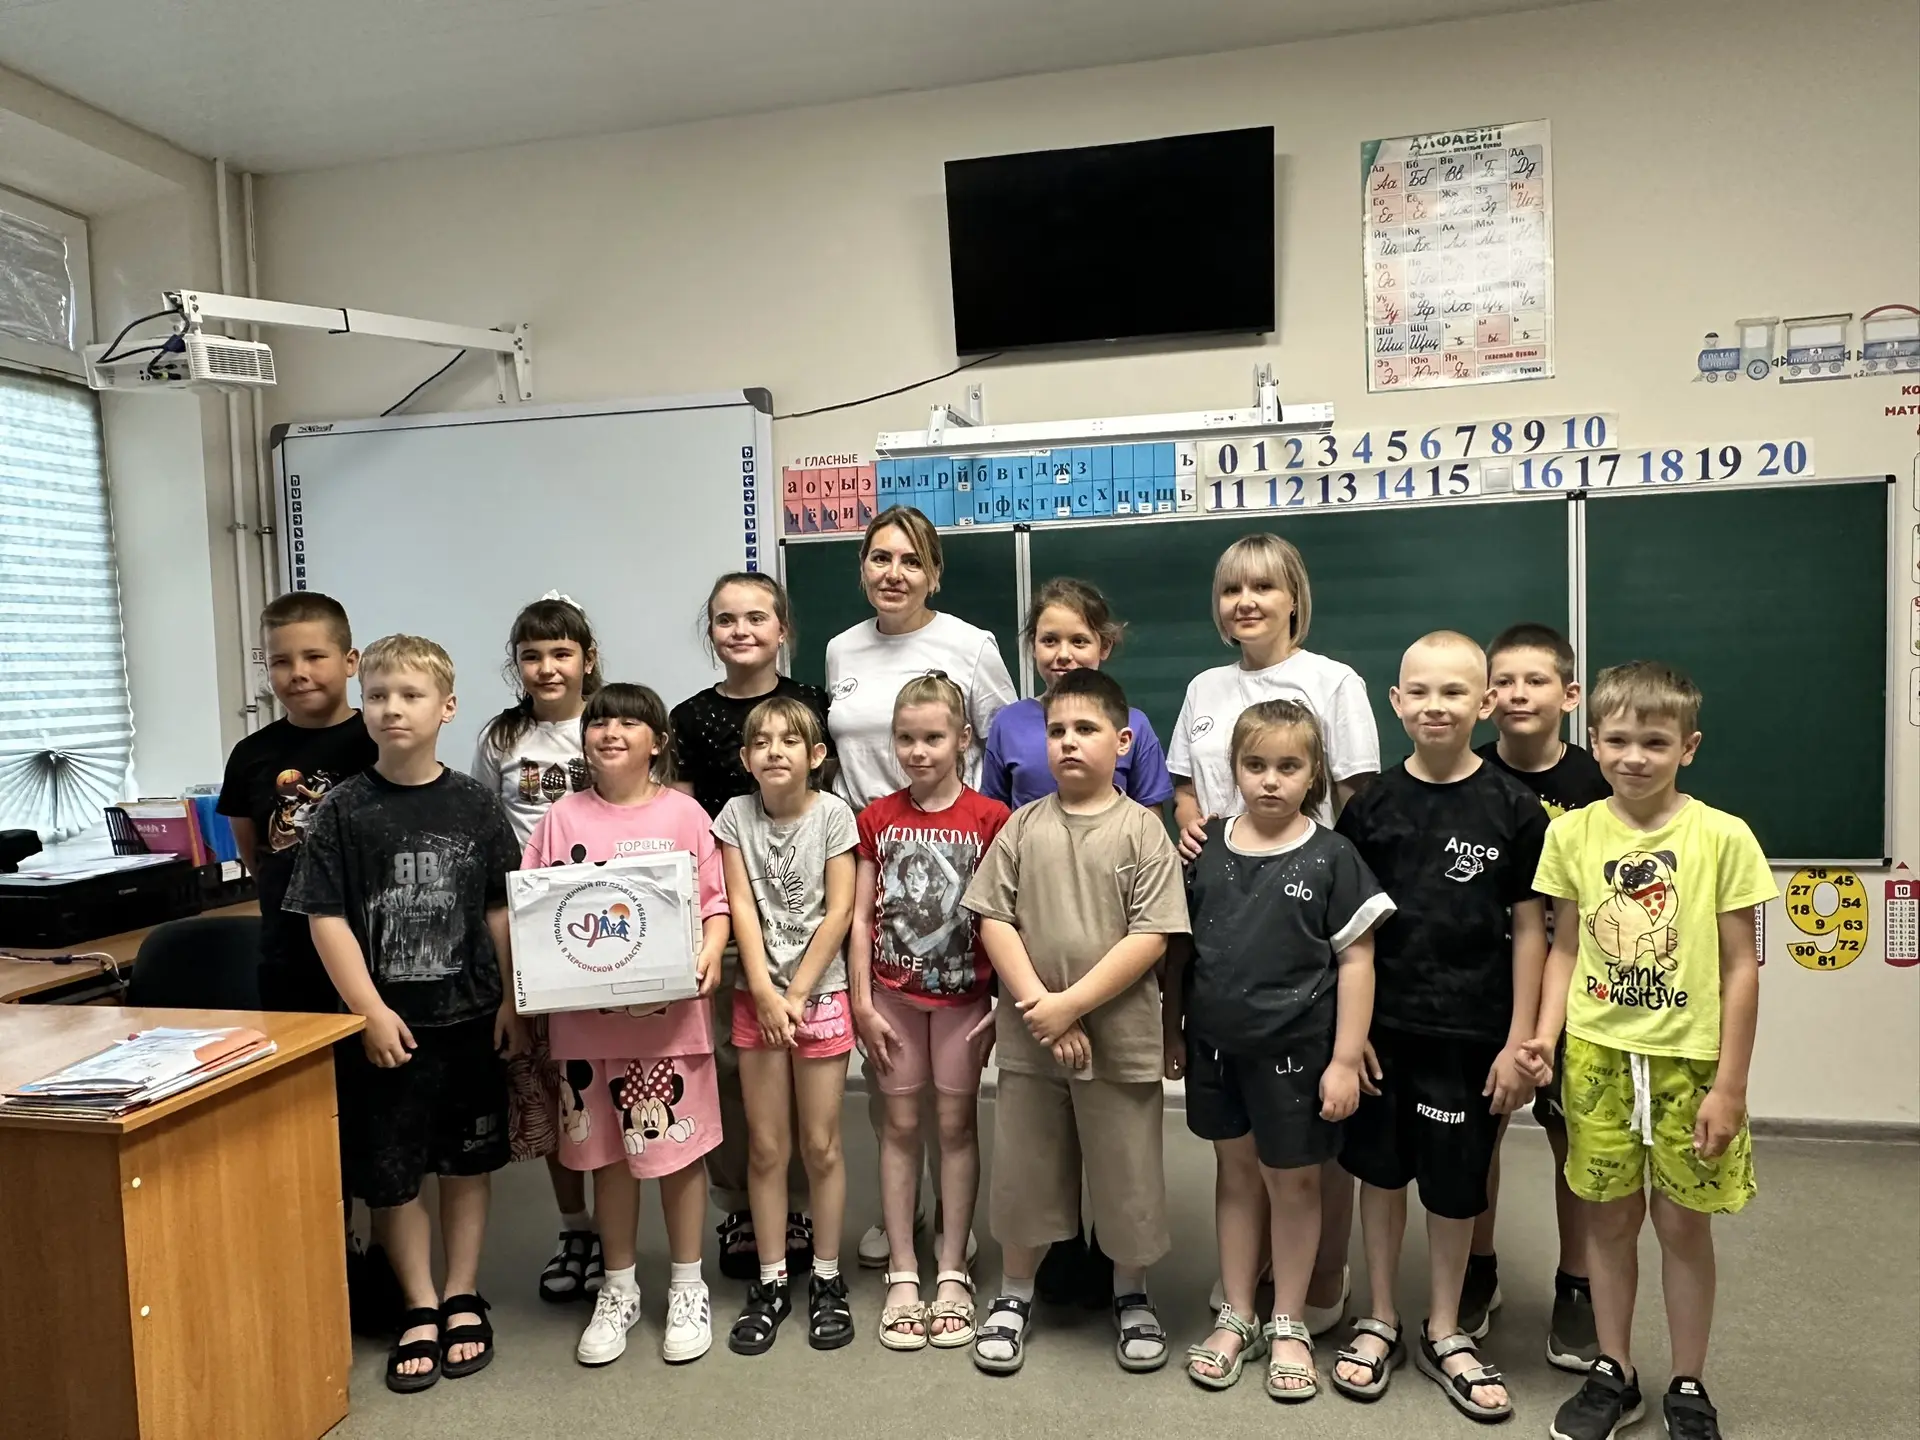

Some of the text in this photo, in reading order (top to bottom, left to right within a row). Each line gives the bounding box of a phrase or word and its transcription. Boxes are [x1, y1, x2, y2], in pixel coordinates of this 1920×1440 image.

[1409, 126, 1503, 151] АЛФАВИТ
[1218, 415, 1606, 475] 0 1 2 3 4 5 6 7 8 9 10
[804, 453, 858, 467] ГЛАСНЫЕ
[787, 453, 1194, 497] а о у ы э н м л р й б в г д ж з ъ
[1209, 440, 1807, 509] 11 12 13 14 15 16 17 18 19 20
[843, 507, 854, 519] и
[863, 506, 872, 518] е
[978, 502, 989, 514] п
[995, 495, 1011, 517] ф
[1017, 497, 1029, 511] к
[1036, 497, 1048, 510] т
[1054, 494, 1071, 508] ш
[1078, 494, 1088, 507] с
[1096, 487, 1108, 501] х
[1118, 490, 1131, 503] ц
[1137, 489, 1149, 503] ч
[1156, 487, 1176, 501] щ
[1181, 489, 1193, 501] ь
[875, 824, 984, 859] WEDNESDAY
[1444, 836, 1500, 861] Ance
[1807, 868, 1827, 879] 36
[1833, 875, 1854, 886] 45
[1284, 880, 1313, 901] alo
[1790, 885, 1811, 895] 27
[1896, 886, 1908, 896] 10
[1841, 898, 1861, 908] 54
[554, 881, 594, 945] УПОЛНОМОЧЕННЫЙ
[1791, 904, 1810, 915] 18
[1815, 919, 1825, 930] 9
[1843, 920, 1863, 930] 63
[1795, 945, 1816, 956] 90
[1838, 940, 1859, 951] 72
[565, 952, 614, 973] ХЕРСОНСКОЙ
[614, 941, 643, 969] ОБЛАСТИ
[1817, 956, 1836, 966] 81
